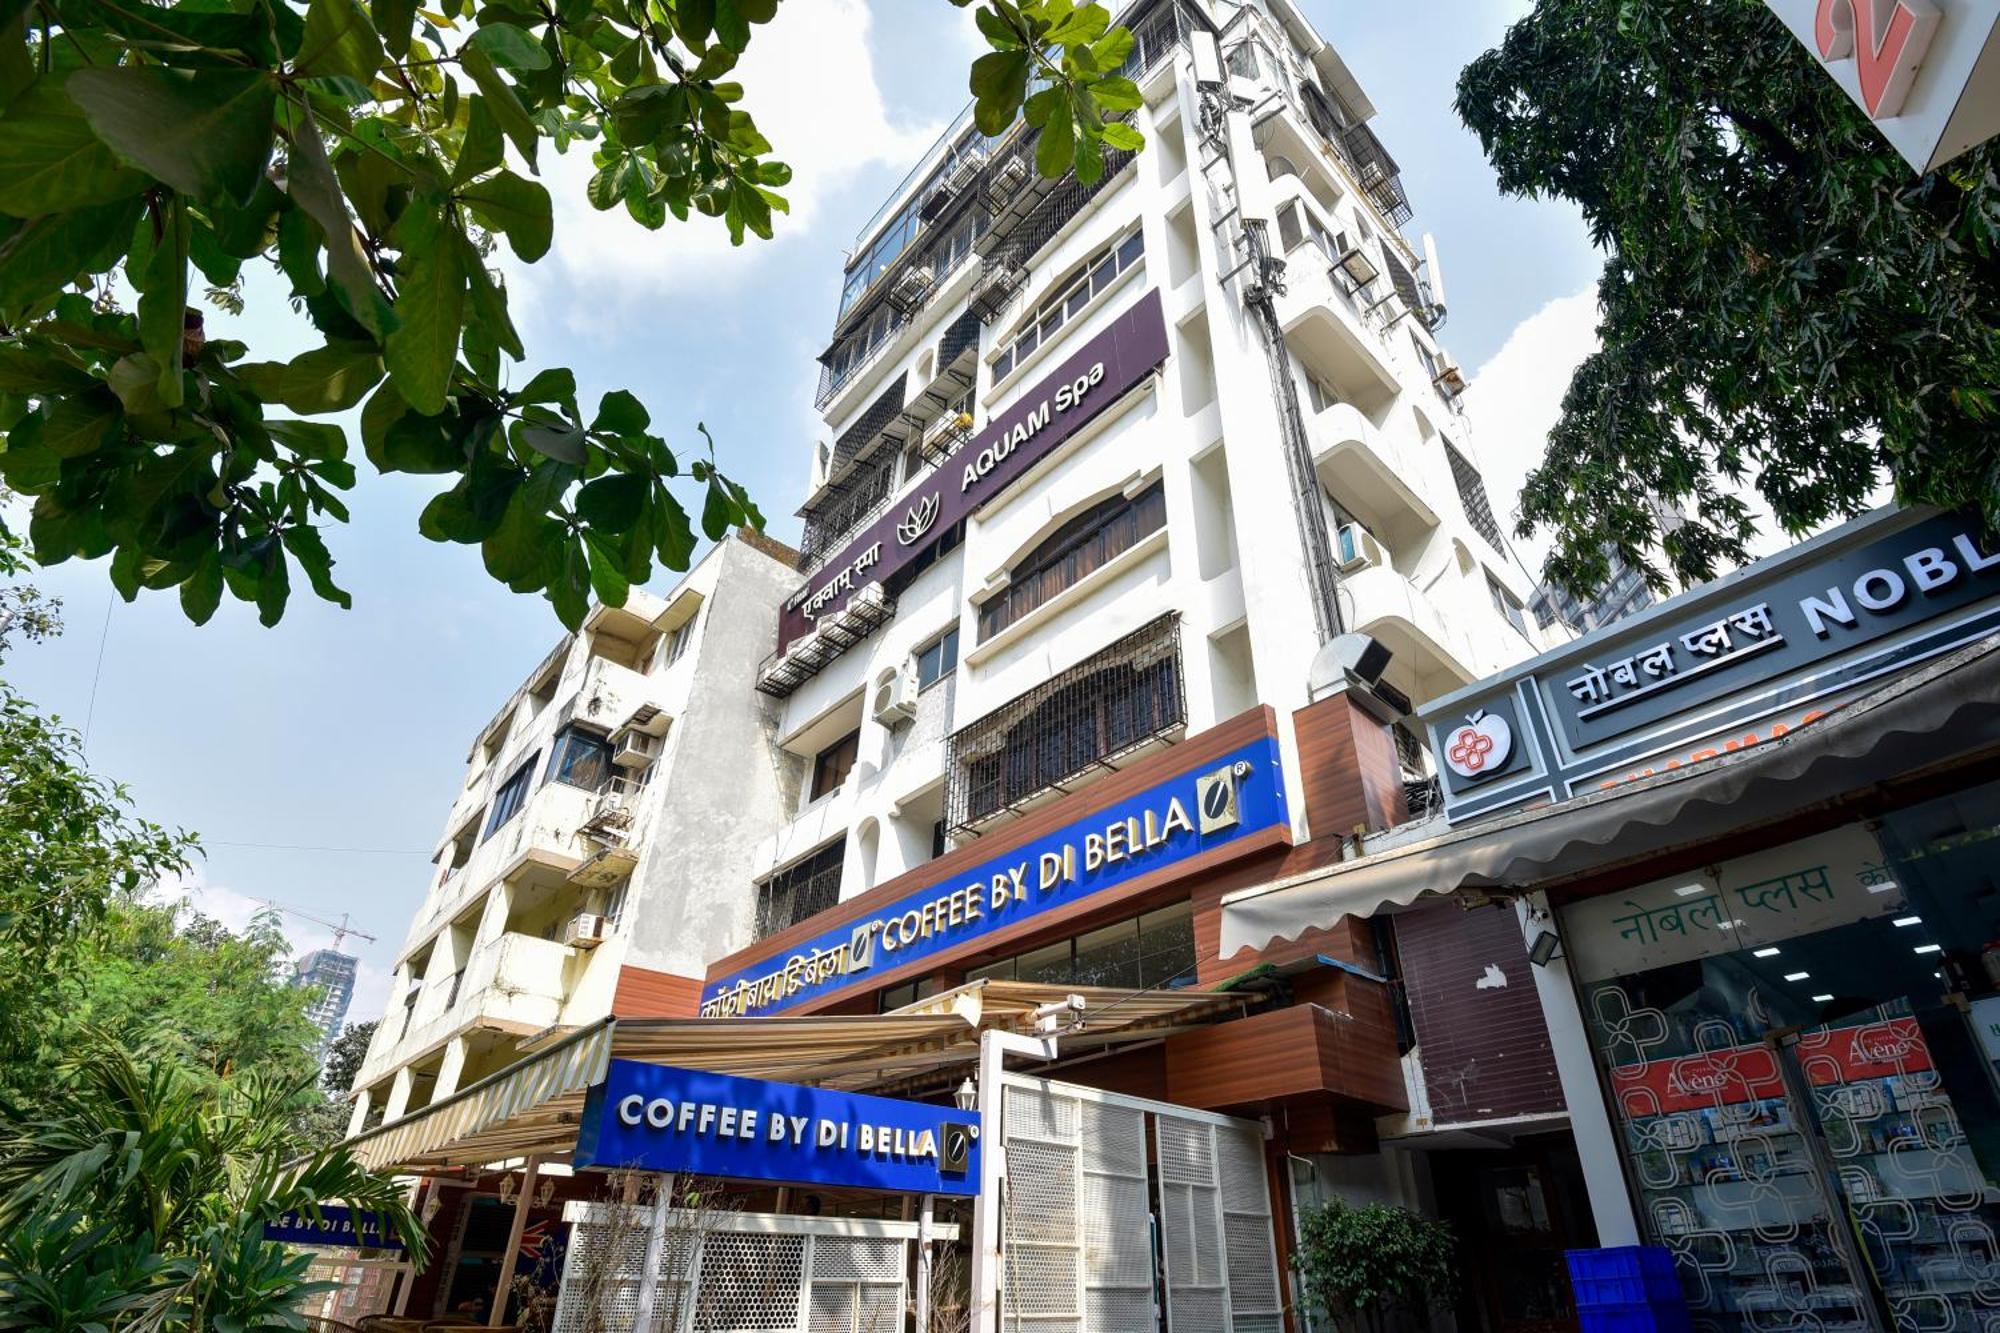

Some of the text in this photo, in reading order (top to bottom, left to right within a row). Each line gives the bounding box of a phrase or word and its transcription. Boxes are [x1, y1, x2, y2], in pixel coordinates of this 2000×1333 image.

[961, 362, 1104, 492] AQUAM Spa
[853, 541, 882, 575] स्पा
[1799, 533, 2000, 636] NOBL
[1566, 602, 1773, 701] नोबल प्लस
[882, 797, 1195, 951] COFFEE BY DI BELLA
[1613, 894, 1726, 945] नोबल
[1735, 864, 1835, 912] प्लस
[747, 970, 783, 1008] बाय
[804, 943, 851, 986] बेला
[618, 1094, 939, 1158] COFFEE BY DI BELLA
[342, 1221, 381, 1235] BLL
